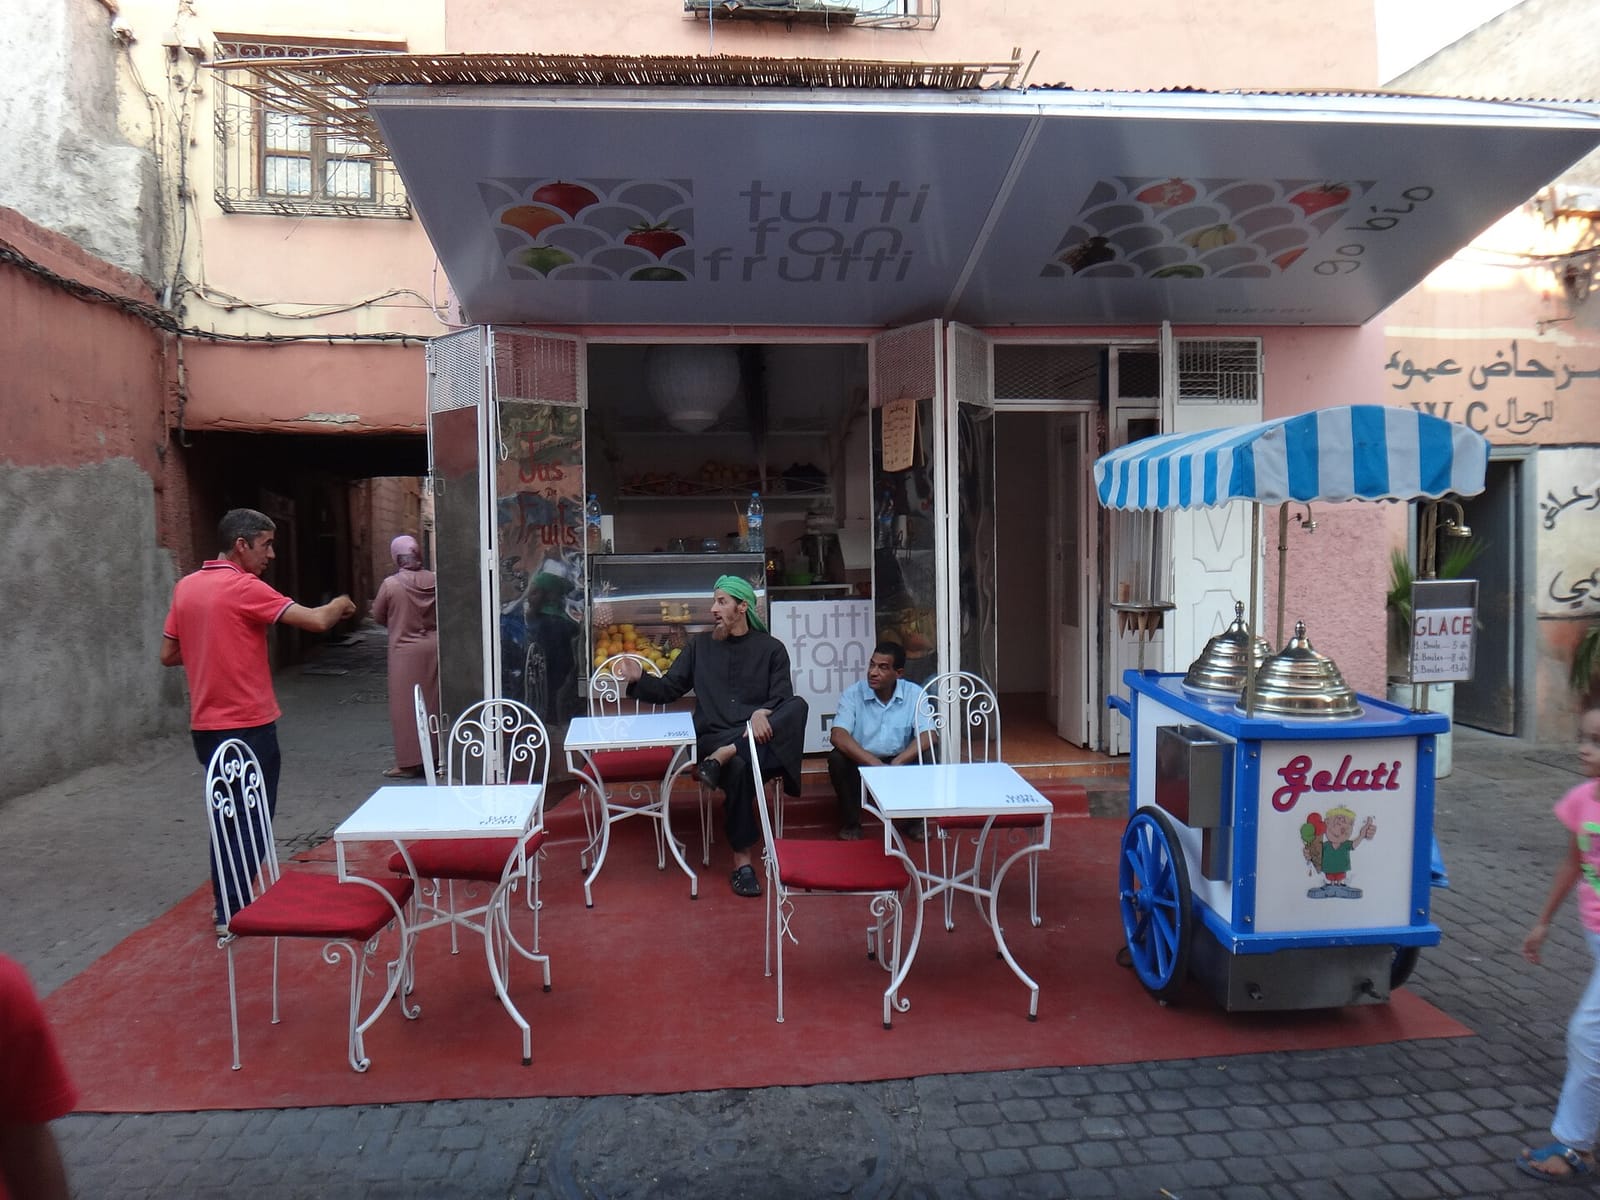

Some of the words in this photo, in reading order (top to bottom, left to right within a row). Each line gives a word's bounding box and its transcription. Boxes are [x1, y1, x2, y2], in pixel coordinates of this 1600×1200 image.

[739, 180, 931, 223] tutti
[750, 216, 904, 256] fan
[702, 247, 914, 283] frutti
[1469, 339, 1600, 391] رحاض
[787, 605, 870, 639] tutti
[1413, 615, 1473, 636] GLACE
[792, 634, 866, 668] fan
[791, 660, 865, 695] rutt
[1272, 754, 1402, 812] Gelati
